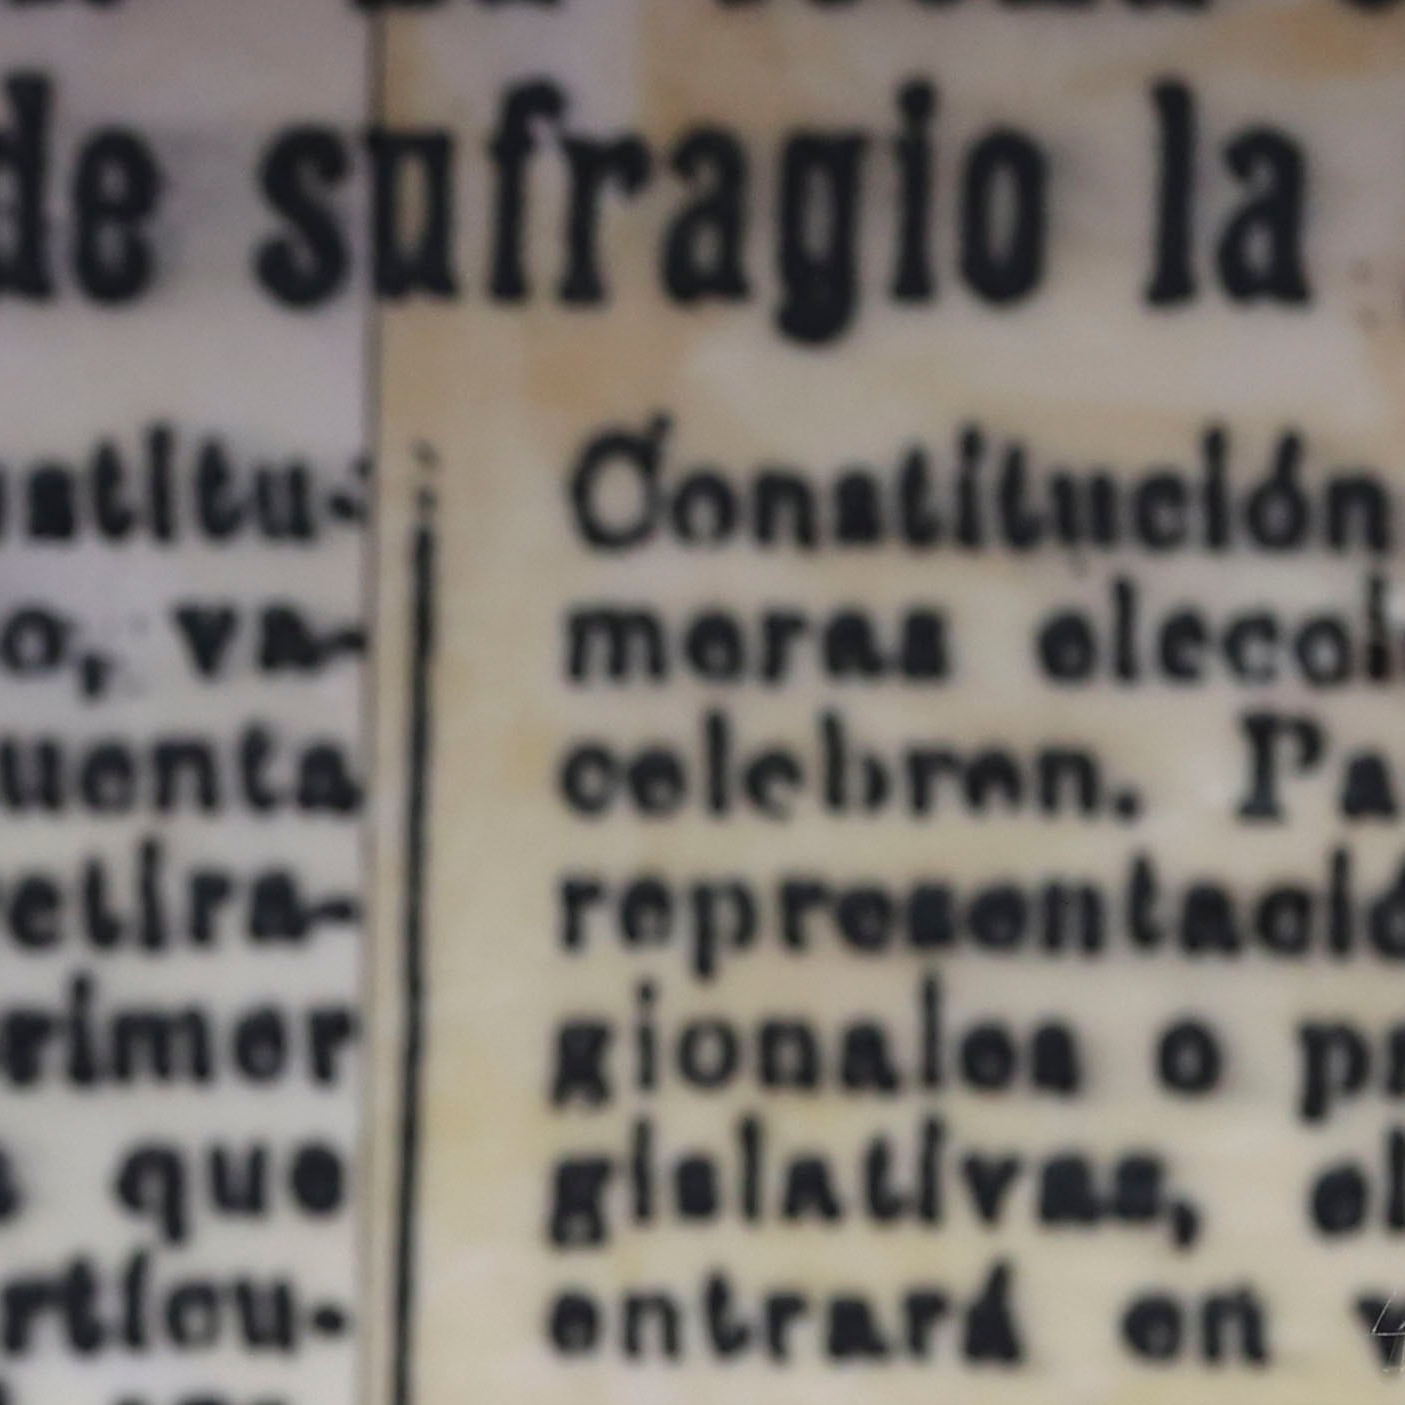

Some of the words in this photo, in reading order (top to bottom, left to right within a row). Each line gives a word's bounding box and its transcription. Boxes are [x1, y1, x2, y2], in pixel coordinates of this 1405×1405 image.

[252, 76, 1054, 348] sufragio
[1146, 76, 1312, 308] la
[567, 412, 1397, 558] Constitución
[567, 607, 950, 684] meras
[1156, 1019, 1224, 1097] o
[113, 1141, 347, 1248] que
[546, 1261, 1026, 1369] entrará
[1120, 1288, 1269, 1366] en
